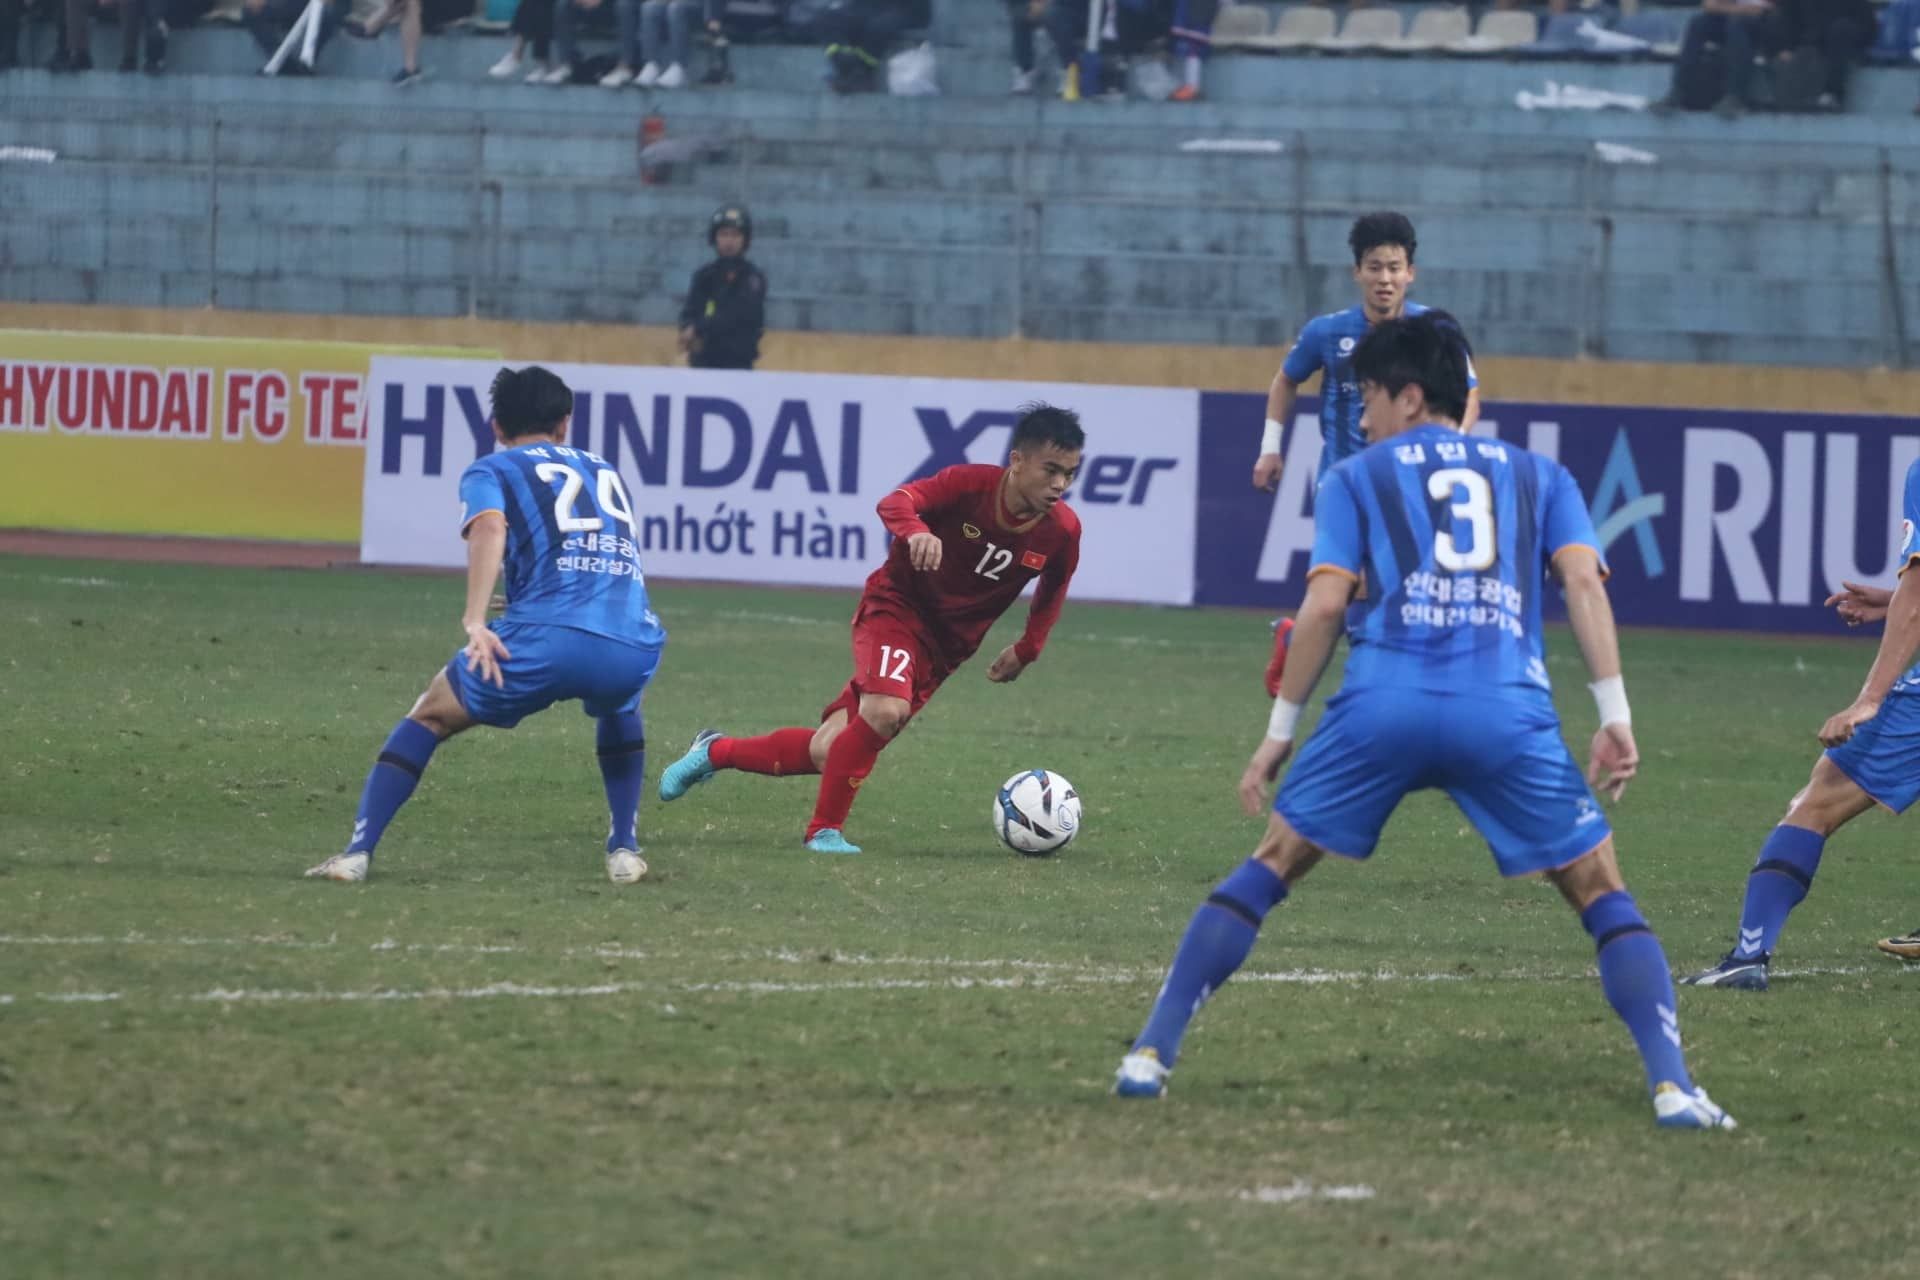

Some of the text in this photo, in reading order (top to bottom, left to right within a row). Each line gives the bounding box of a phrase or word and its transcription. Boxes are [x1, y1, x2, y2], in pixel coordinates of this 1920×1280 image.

[0, 364, 368, 440] HYUNDAI FC TE
[643, 502, 755, 556] nhớt
[772, 507, 866, 561] Hàn
[1427, 467, 1496, 571] 3
[974, 542, 1013, 581] 12
[879, 645, 911, 683] 12
